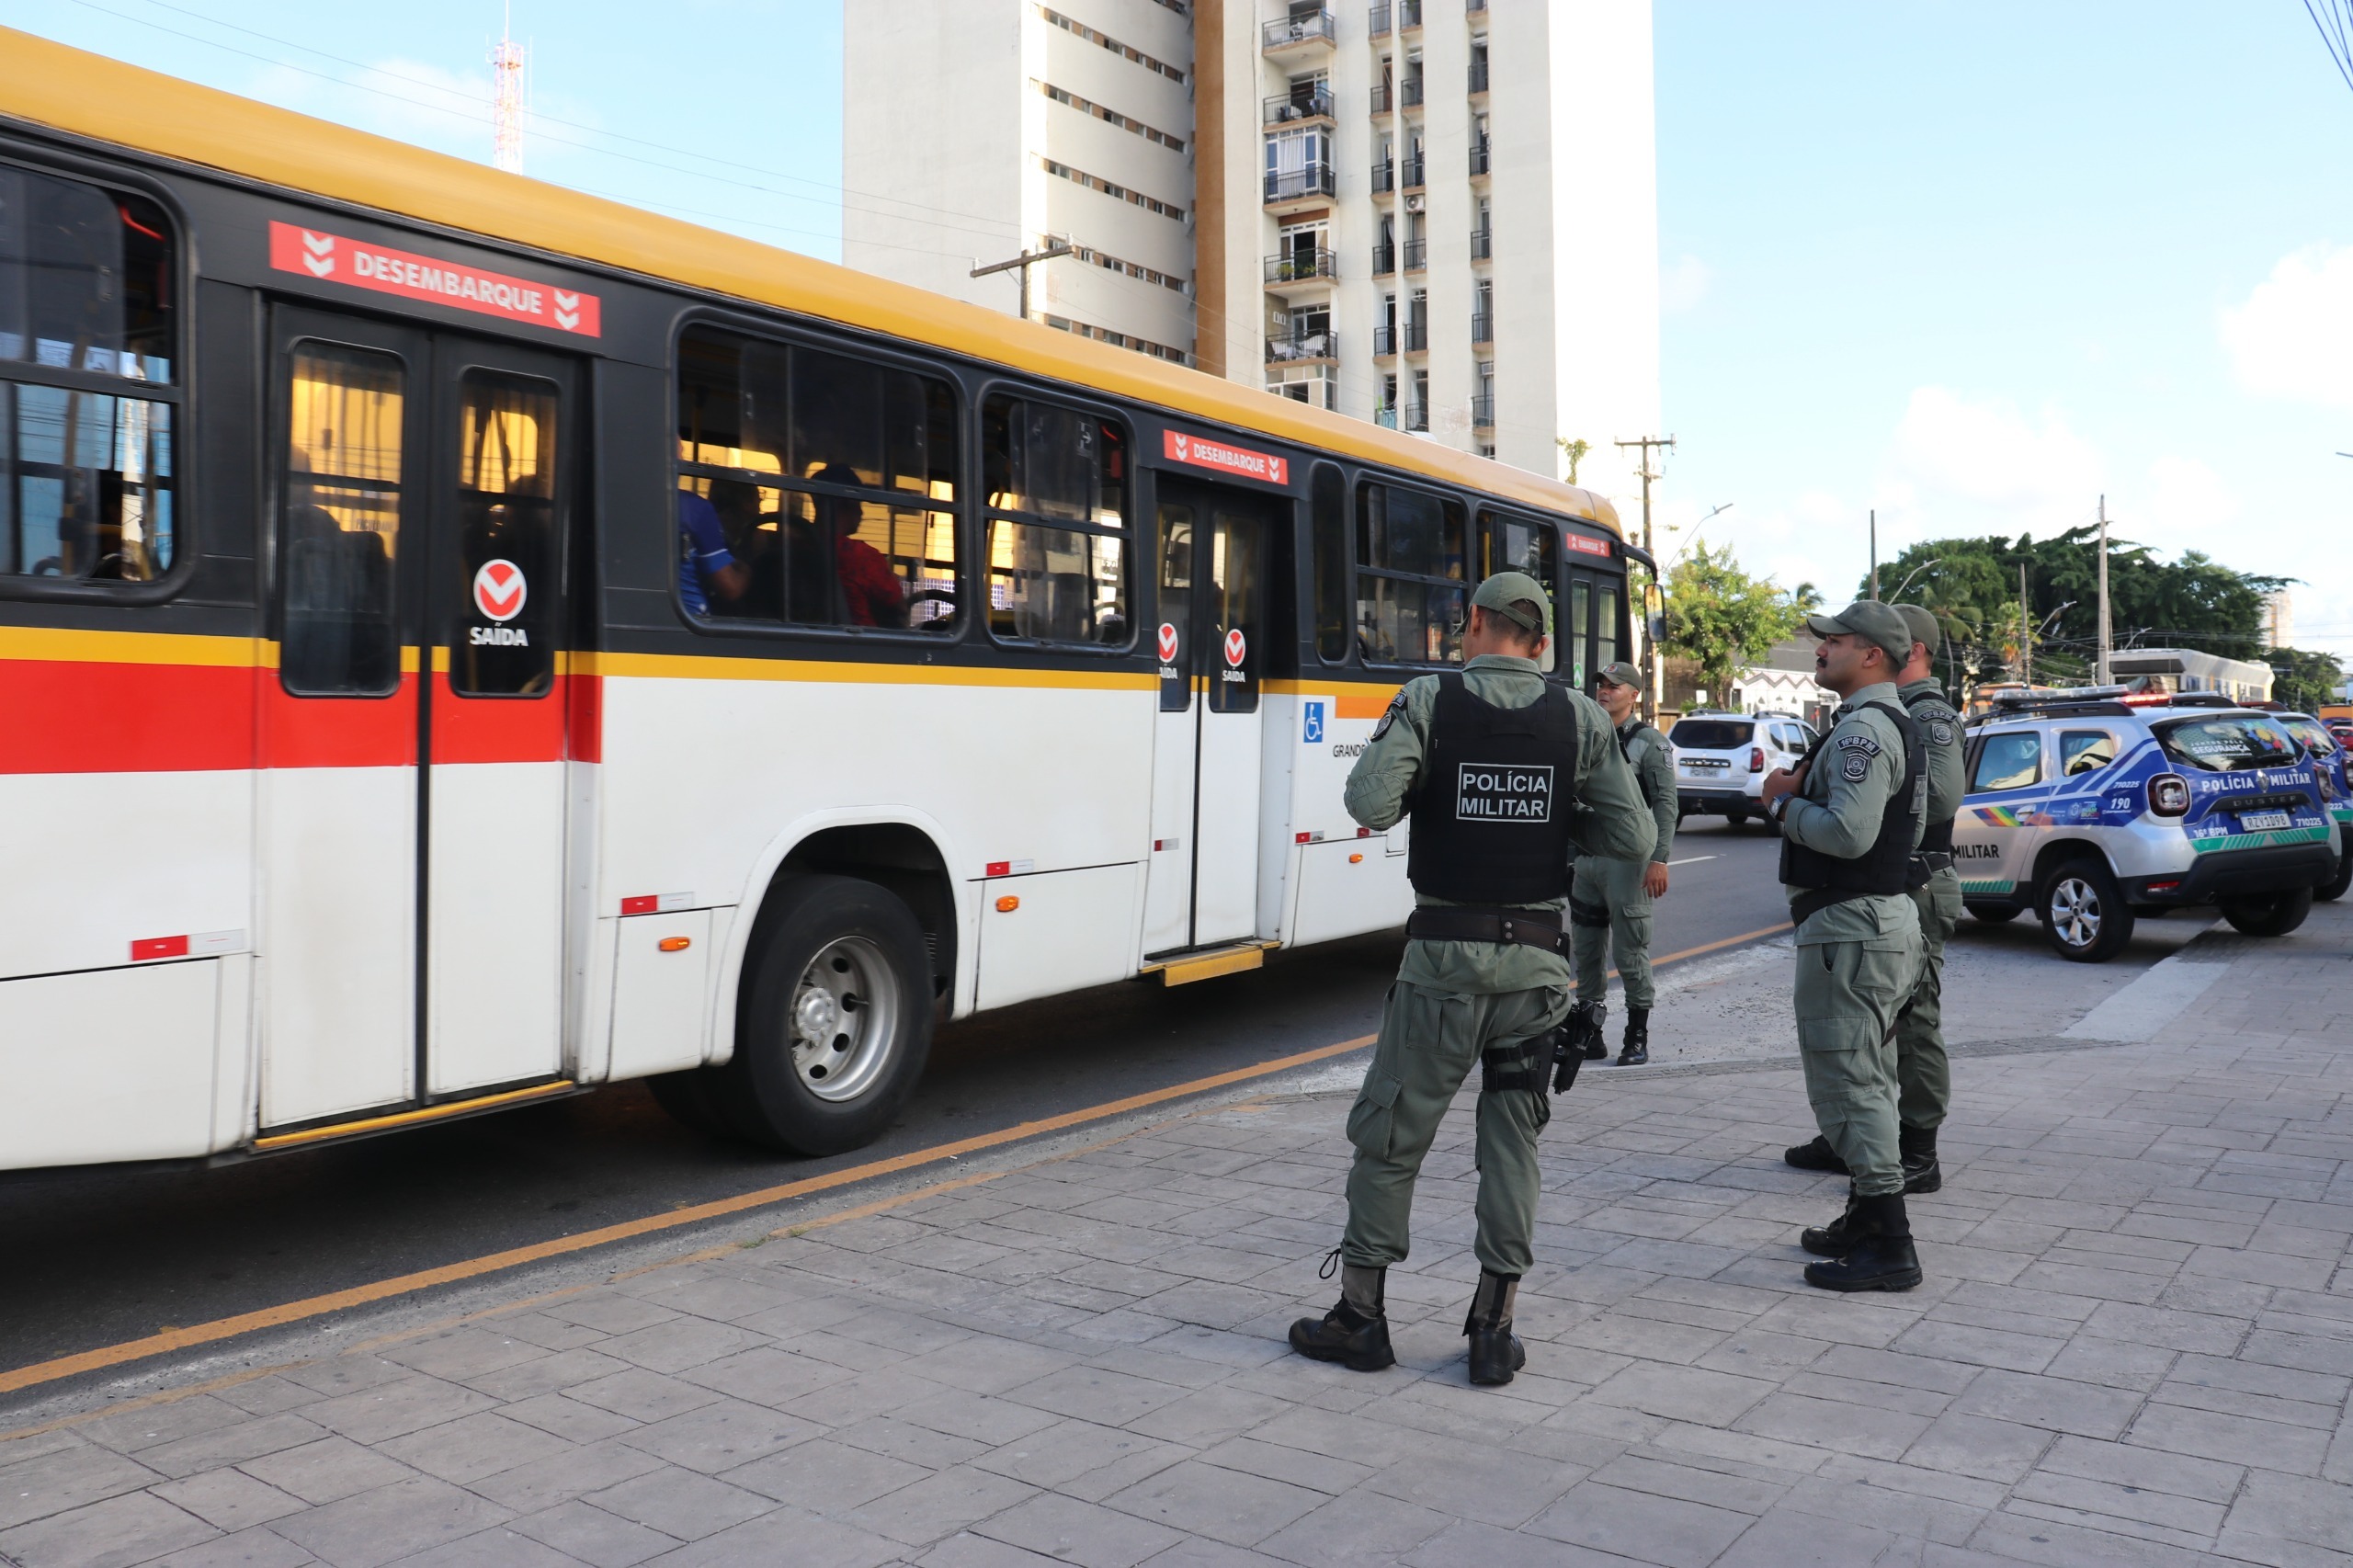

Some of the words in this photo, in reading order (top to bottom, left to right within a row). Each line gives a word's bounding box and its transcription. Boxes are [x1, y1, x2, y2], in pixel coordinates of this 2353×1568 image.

[354, 250, 542, 314] DESEMBARQUE
[1193, 443, 1266, 473] DESEMBARQUE
[470, 622, 529, 646] SAÍDA
[1159, 664, 1178, 679] AÍDA
[1222, 666, 1246, 683] SAÍDA
[2191, 744, 2252, 754] SEGURANÇA
[1462, 770, 1548, 792] POLÍCIA
[2113, 780, 2141, 789] 710225
[2200, 775, 2255, 792] POLÍCIA
[2269, 772, 2312, 786] MILITAR
[1461, 797, 1544, 816] MILITAR
[2110, 797, 2131, 810] 190
[2233, 795, 2296, 807] DUSTER
[2246, 814, 2287, 829] RZY1D98
[2295, 817, 2323, 827] 710225
[2208, 825, 2229, 836] BPM
[1949, 844, 2000, 858] MILITAR
